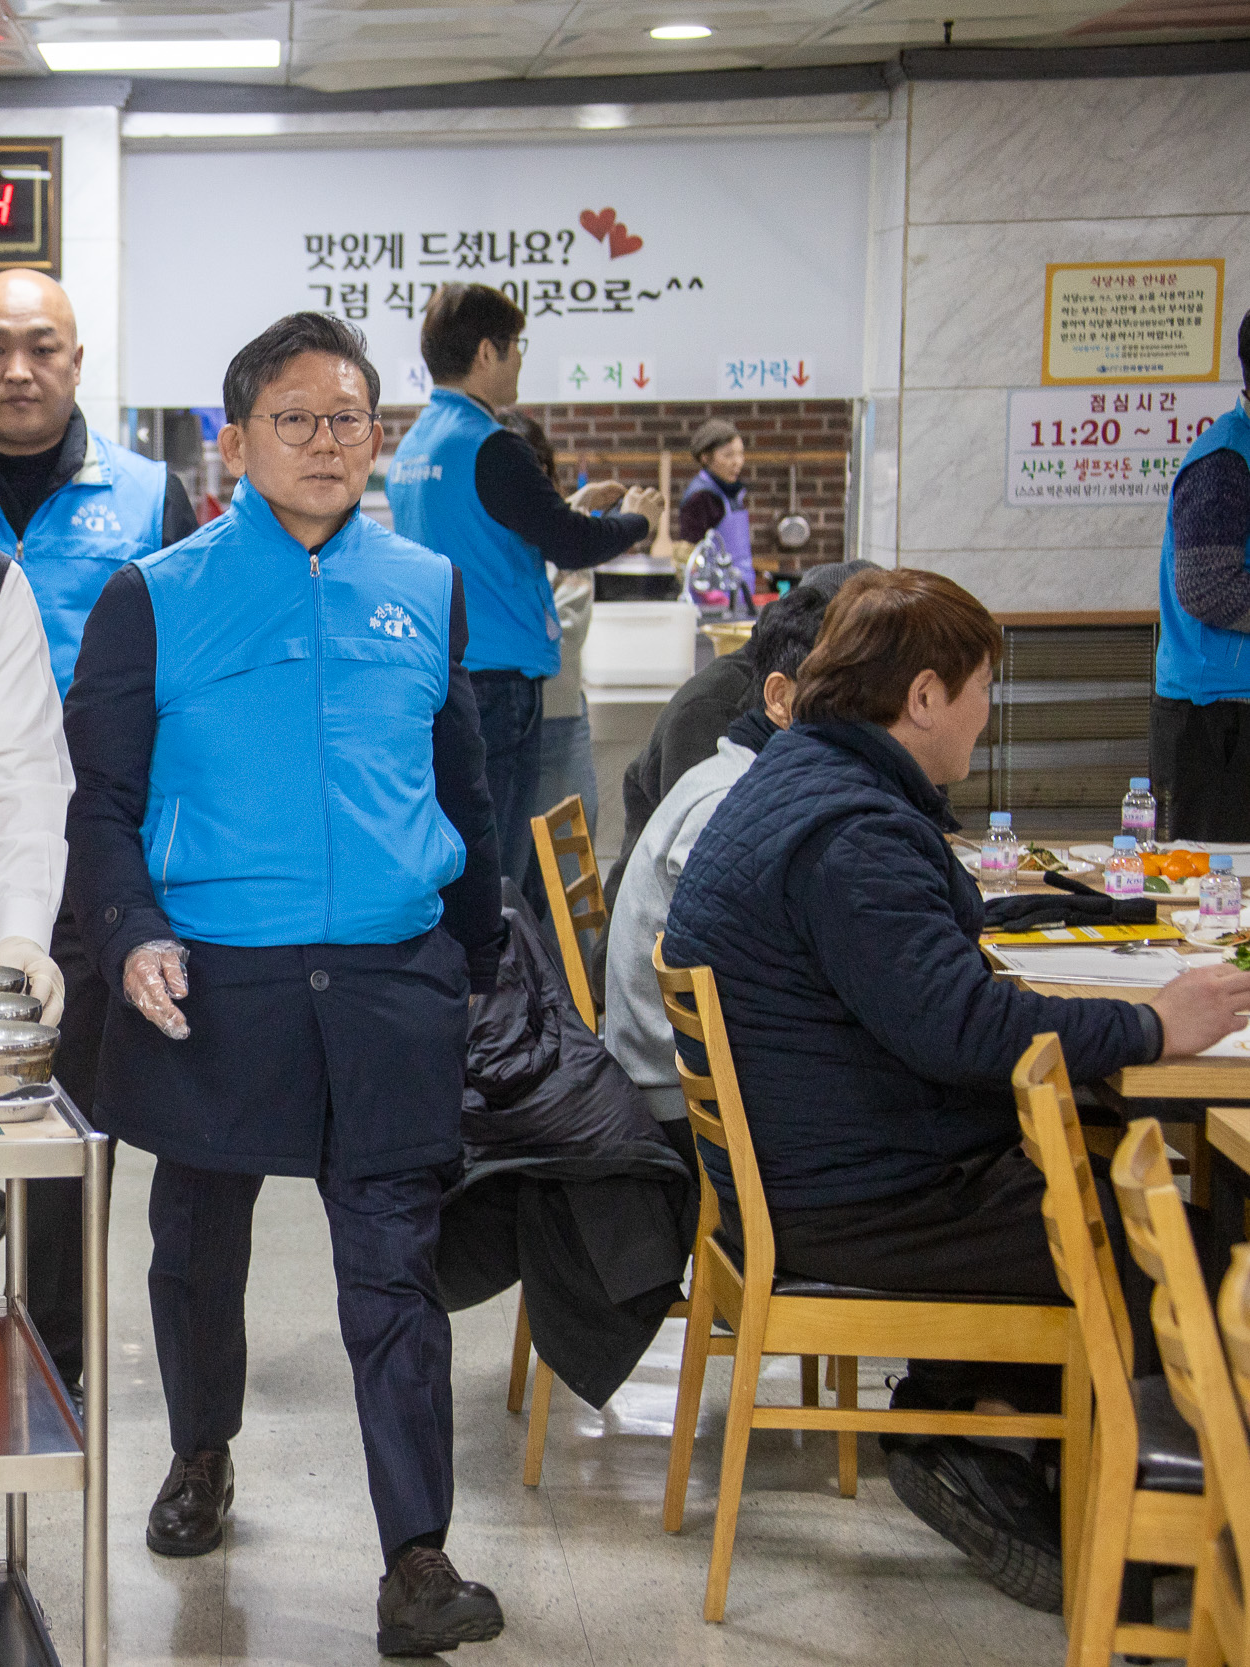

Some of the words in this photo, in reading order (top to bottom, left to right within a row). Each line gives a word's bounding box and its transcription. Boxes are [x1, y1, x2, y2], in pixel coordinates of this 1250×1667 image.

[304, 232, 404, 271] 맛있게
[418, 230, 576, 269] 드셨나요?
[306, 281, 369, 319] 그럼
[725, 359, 791, 389] 젓가락
[1031, 419, 1121, 447] 11:20
